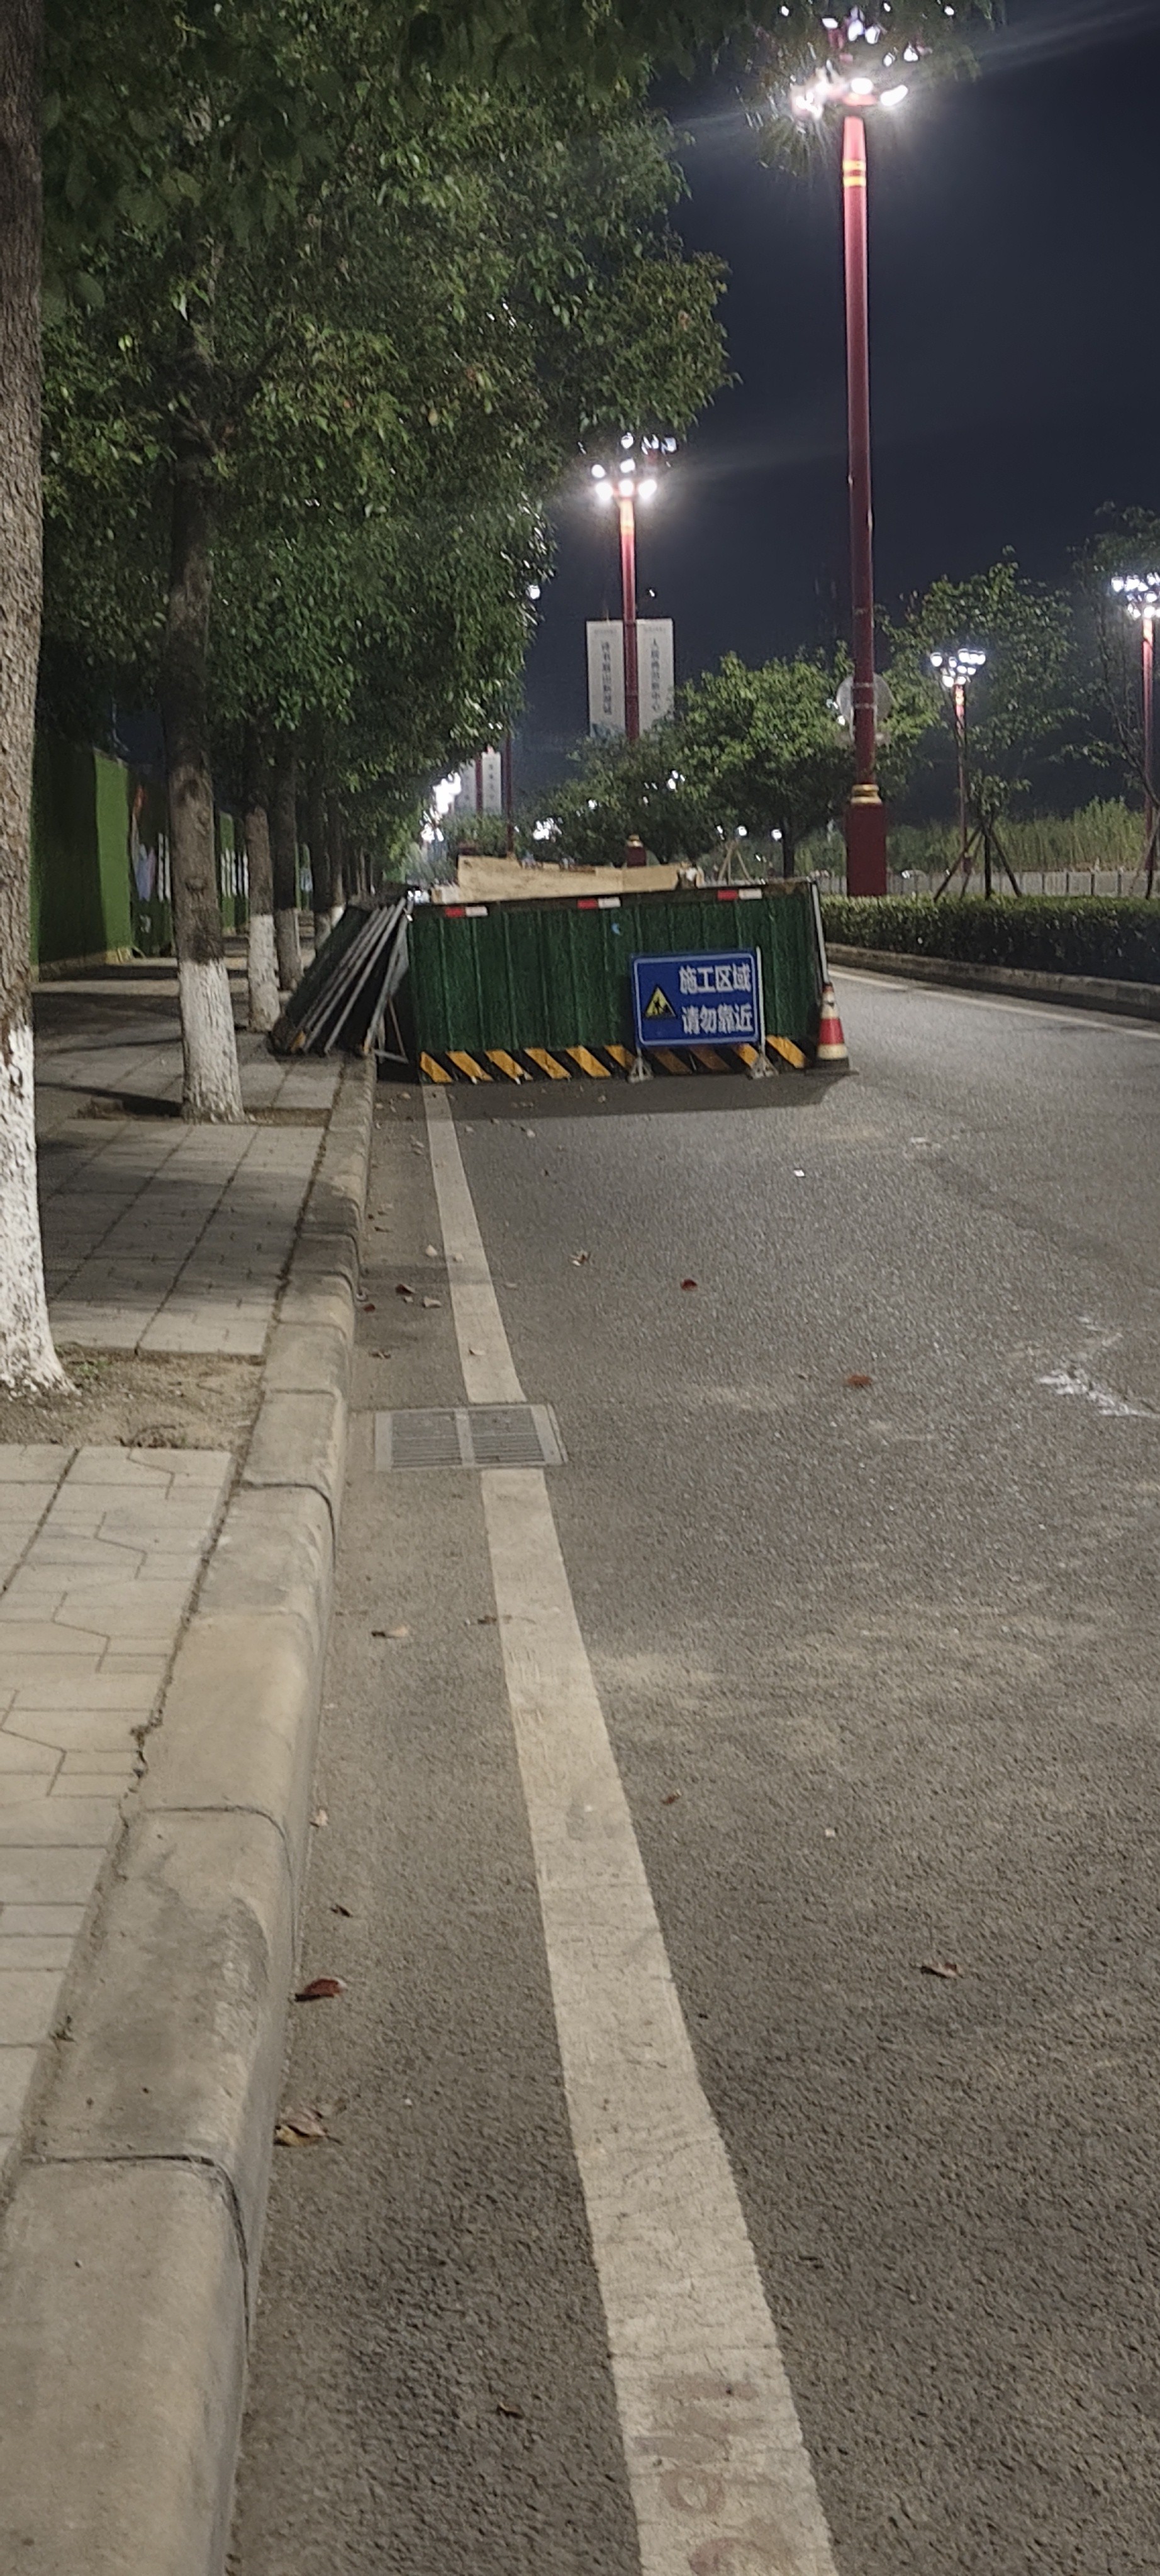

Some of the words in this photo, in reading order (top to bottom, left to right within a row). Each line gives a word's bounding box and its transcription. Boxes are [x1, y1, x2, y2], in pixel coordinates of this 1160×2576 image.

[679, 963, 752, 994] 施工区域
[681, 1002, 754, 1035] 请勿靠近
